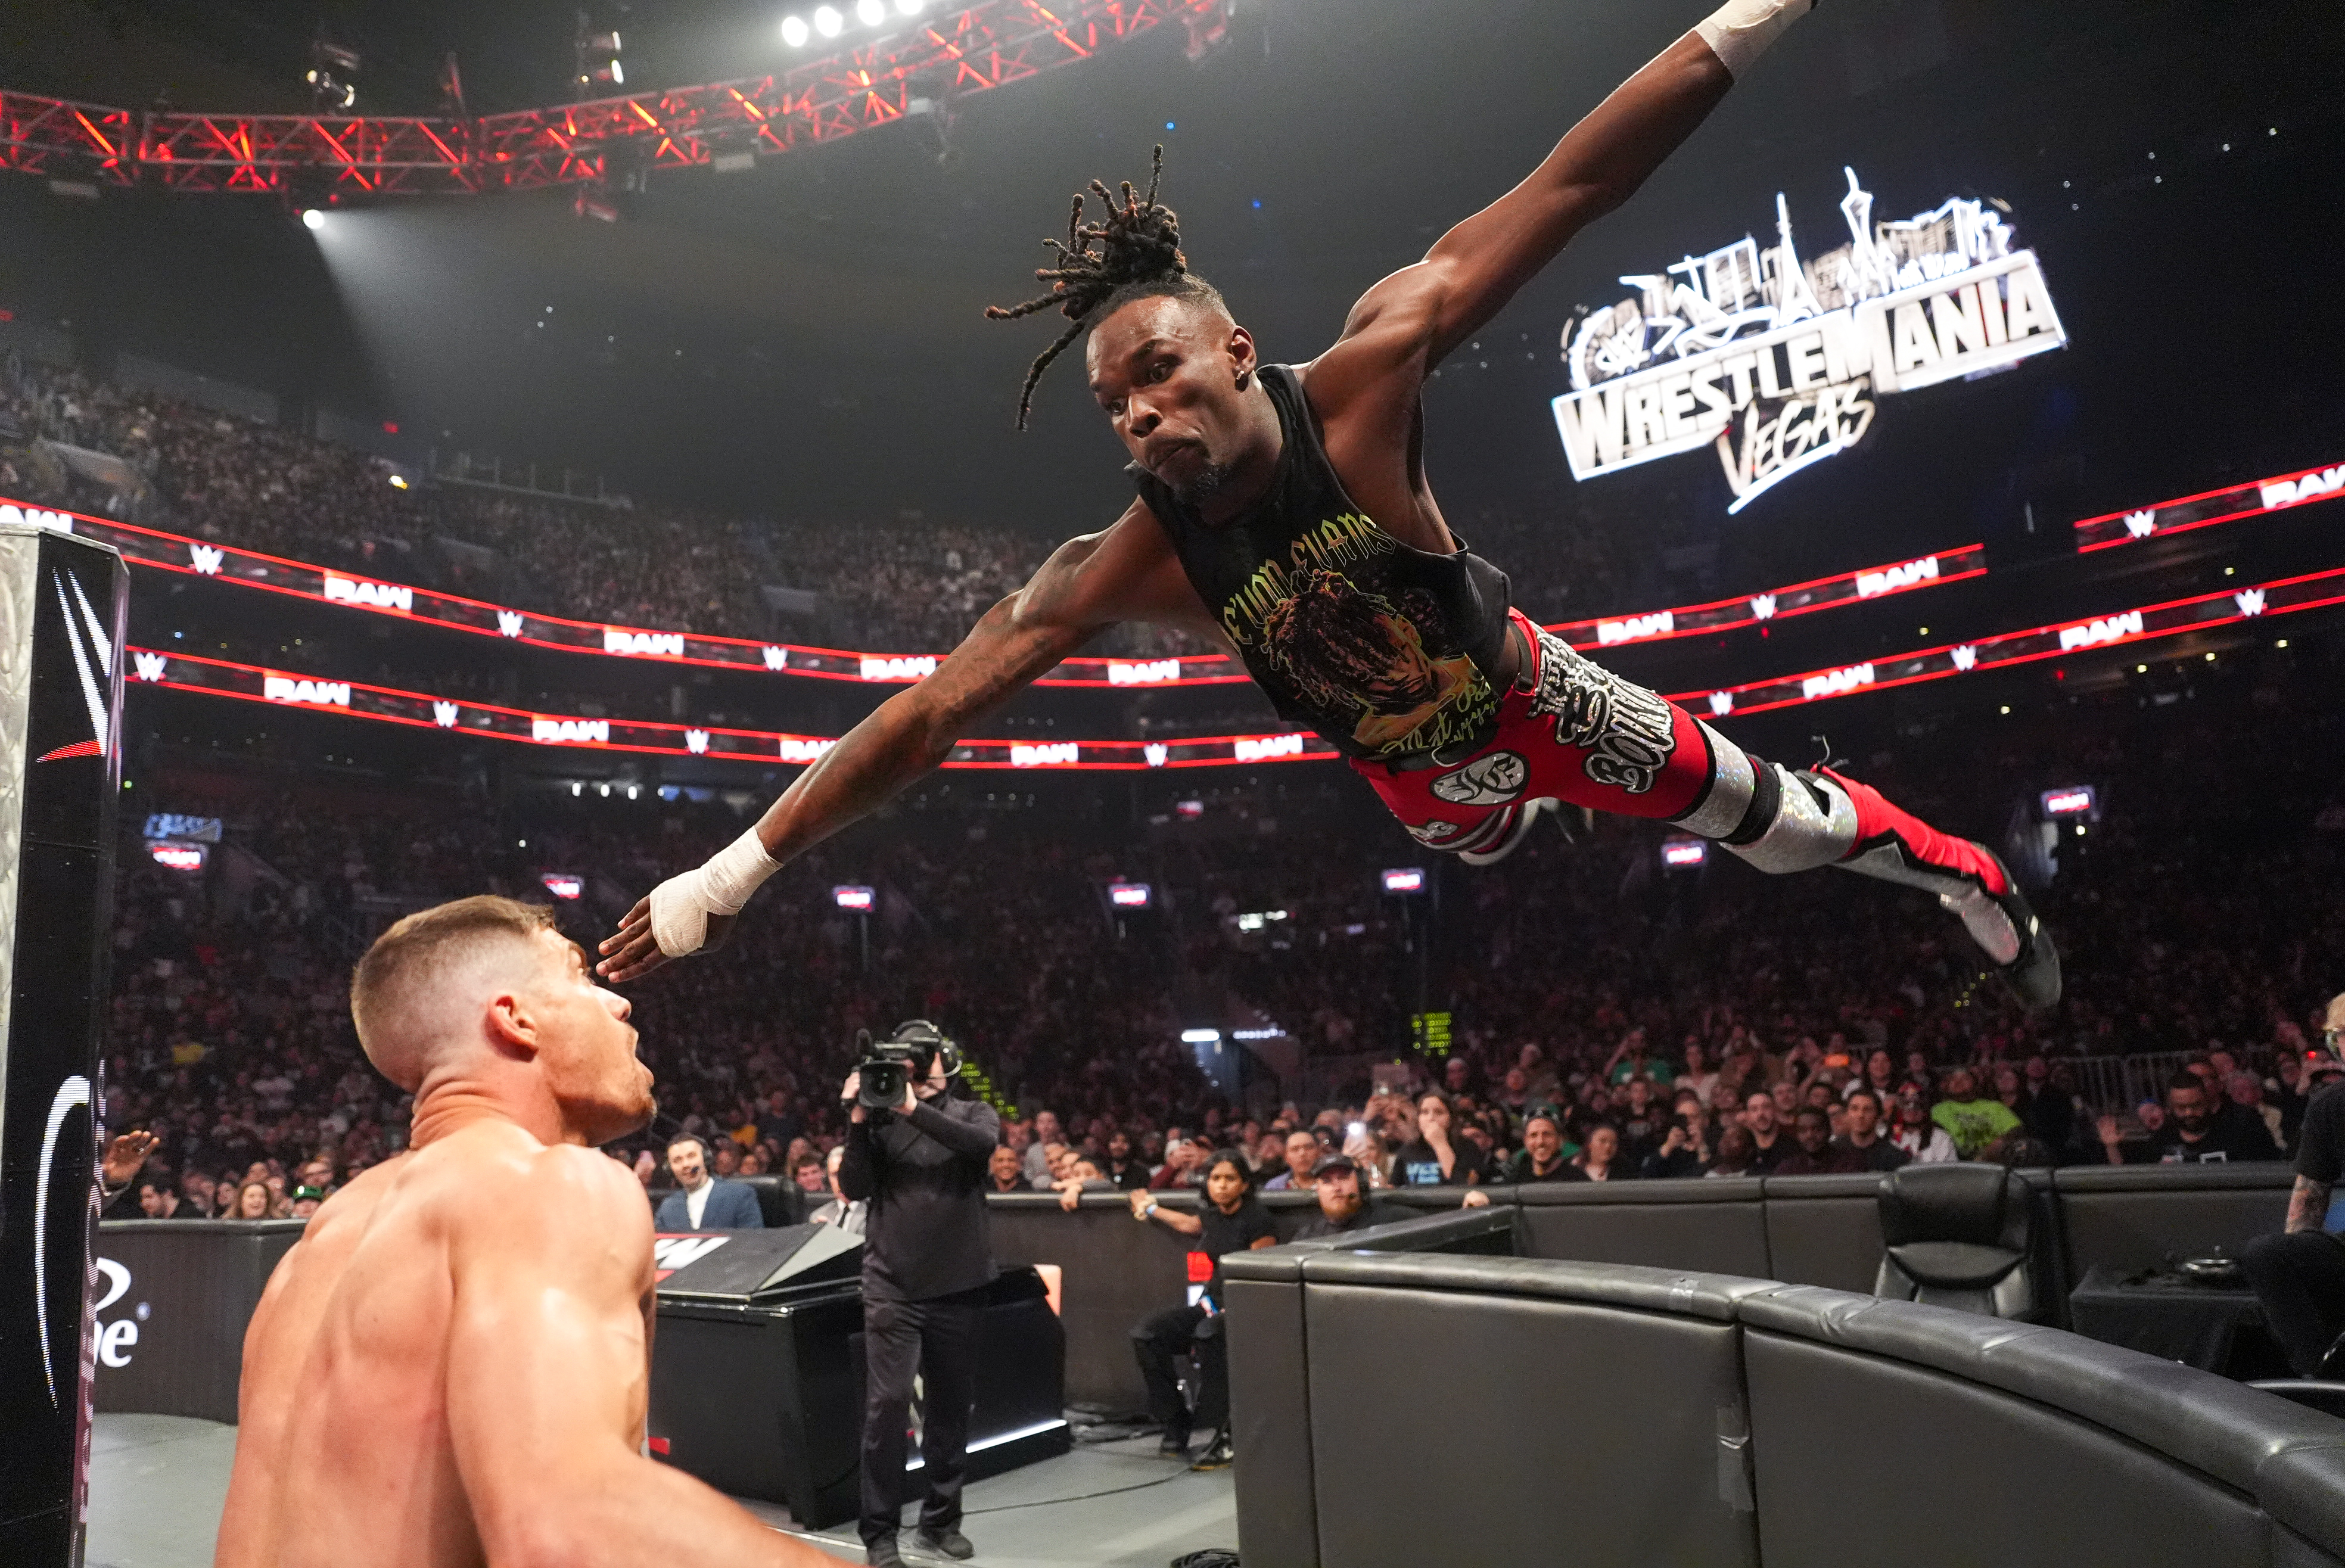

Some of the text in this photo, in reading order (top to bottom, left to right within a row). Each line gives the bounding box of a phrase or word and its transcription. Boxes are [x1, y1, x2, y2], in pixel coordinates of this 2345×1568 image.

[1563, 267, 2058, 475] WRESTLEMANIA
[1717, 384, 1876, 498] VEGAS
[0, 505, 73, 534] AW
